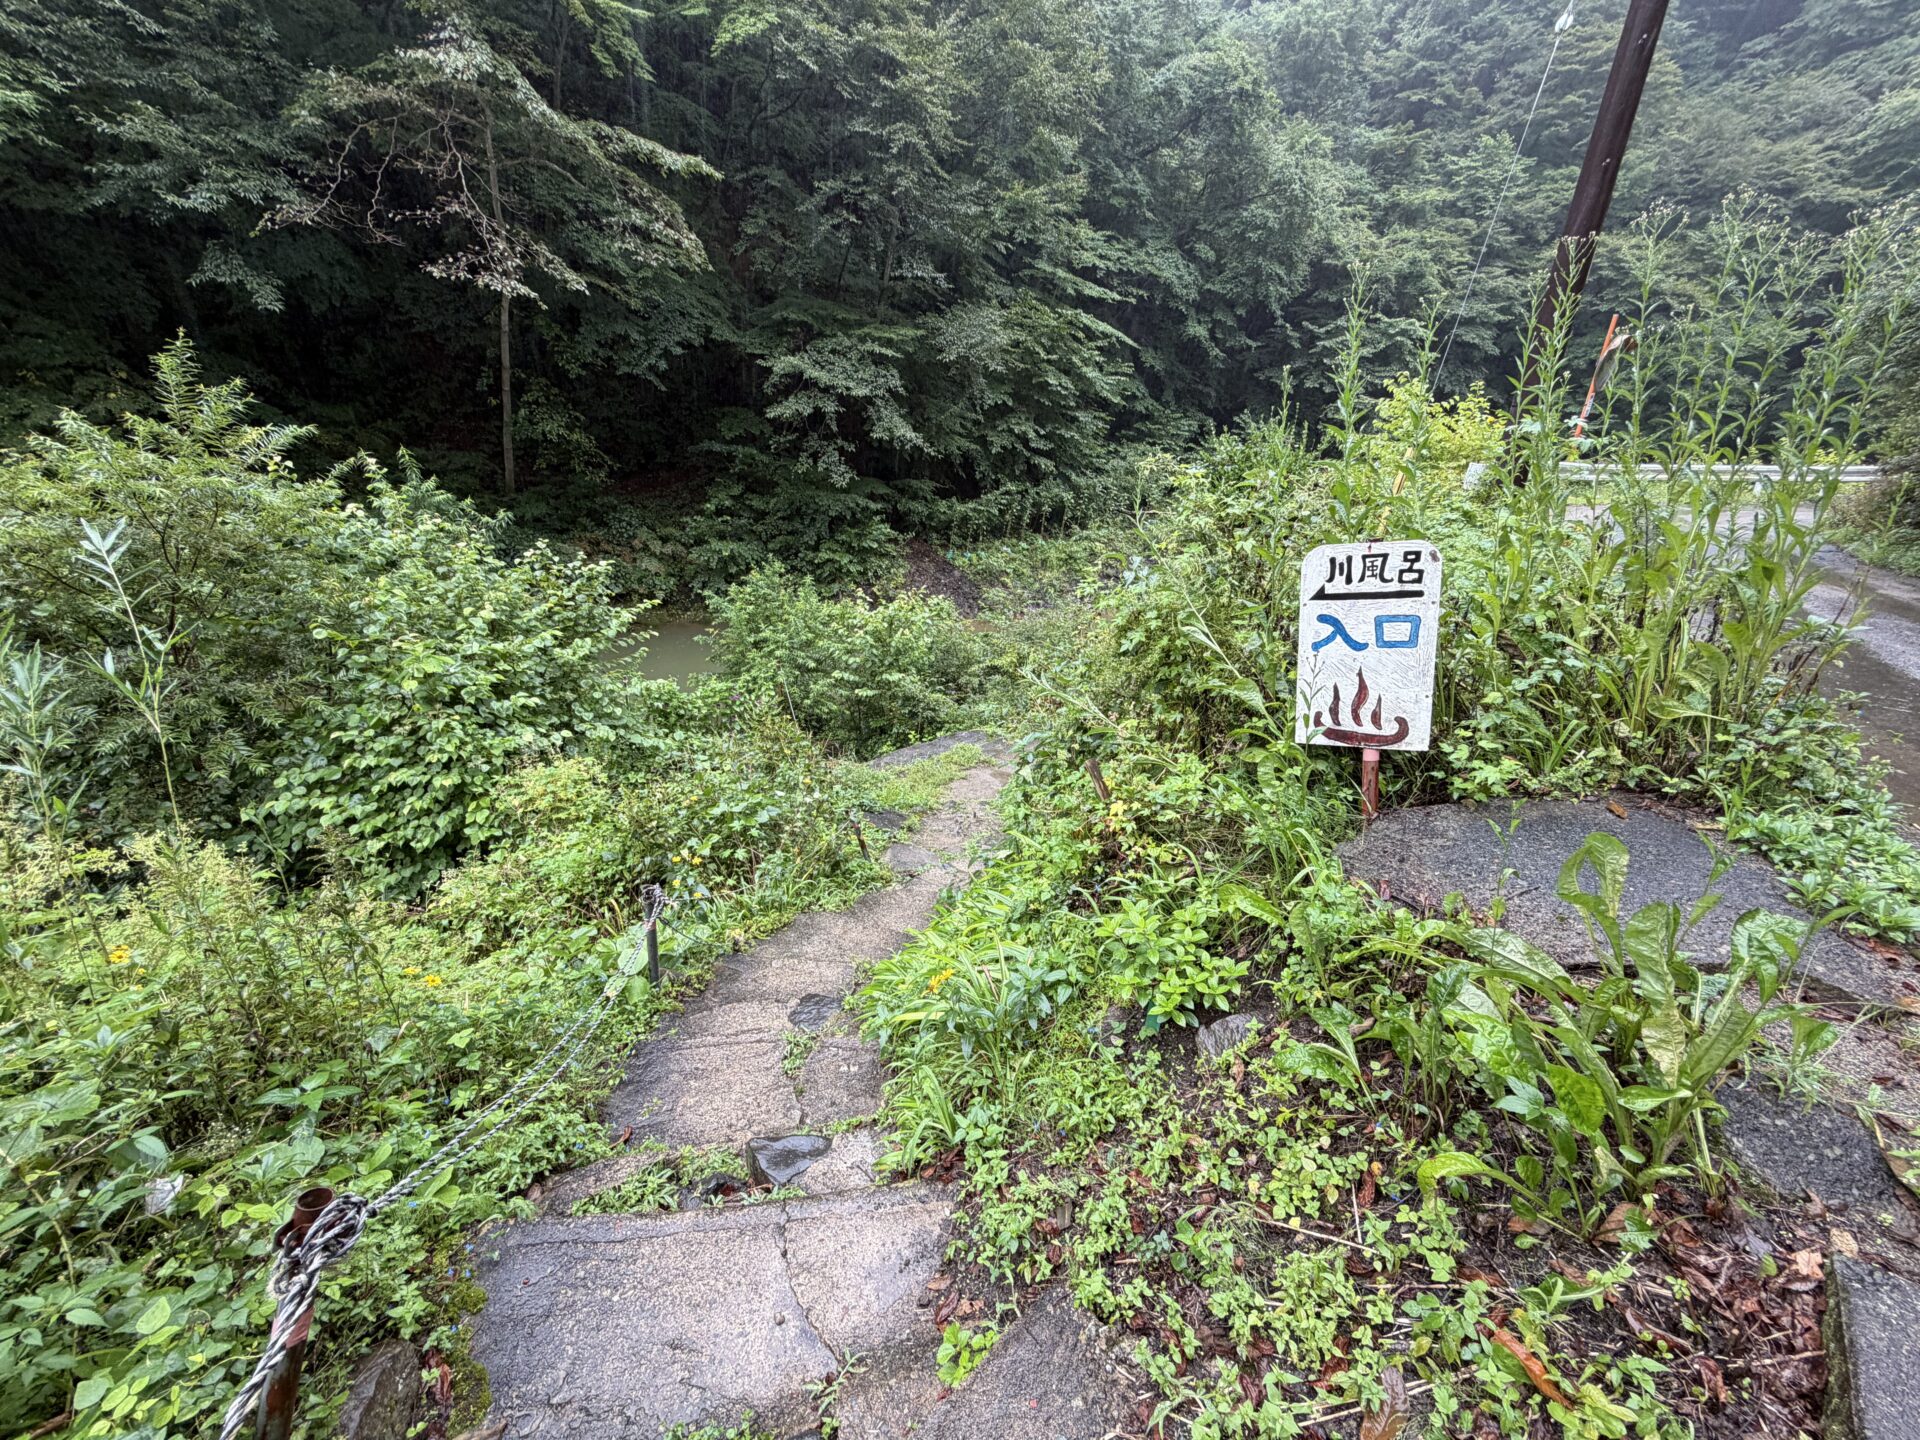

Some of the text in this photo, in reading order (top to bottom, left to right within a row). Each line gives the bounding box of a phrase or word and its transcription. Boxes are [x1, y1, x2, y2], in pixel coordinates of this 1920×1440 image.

[1325, 550, 1425, 585] 川風呂
[1311, 614, 1421, 652] 入口
